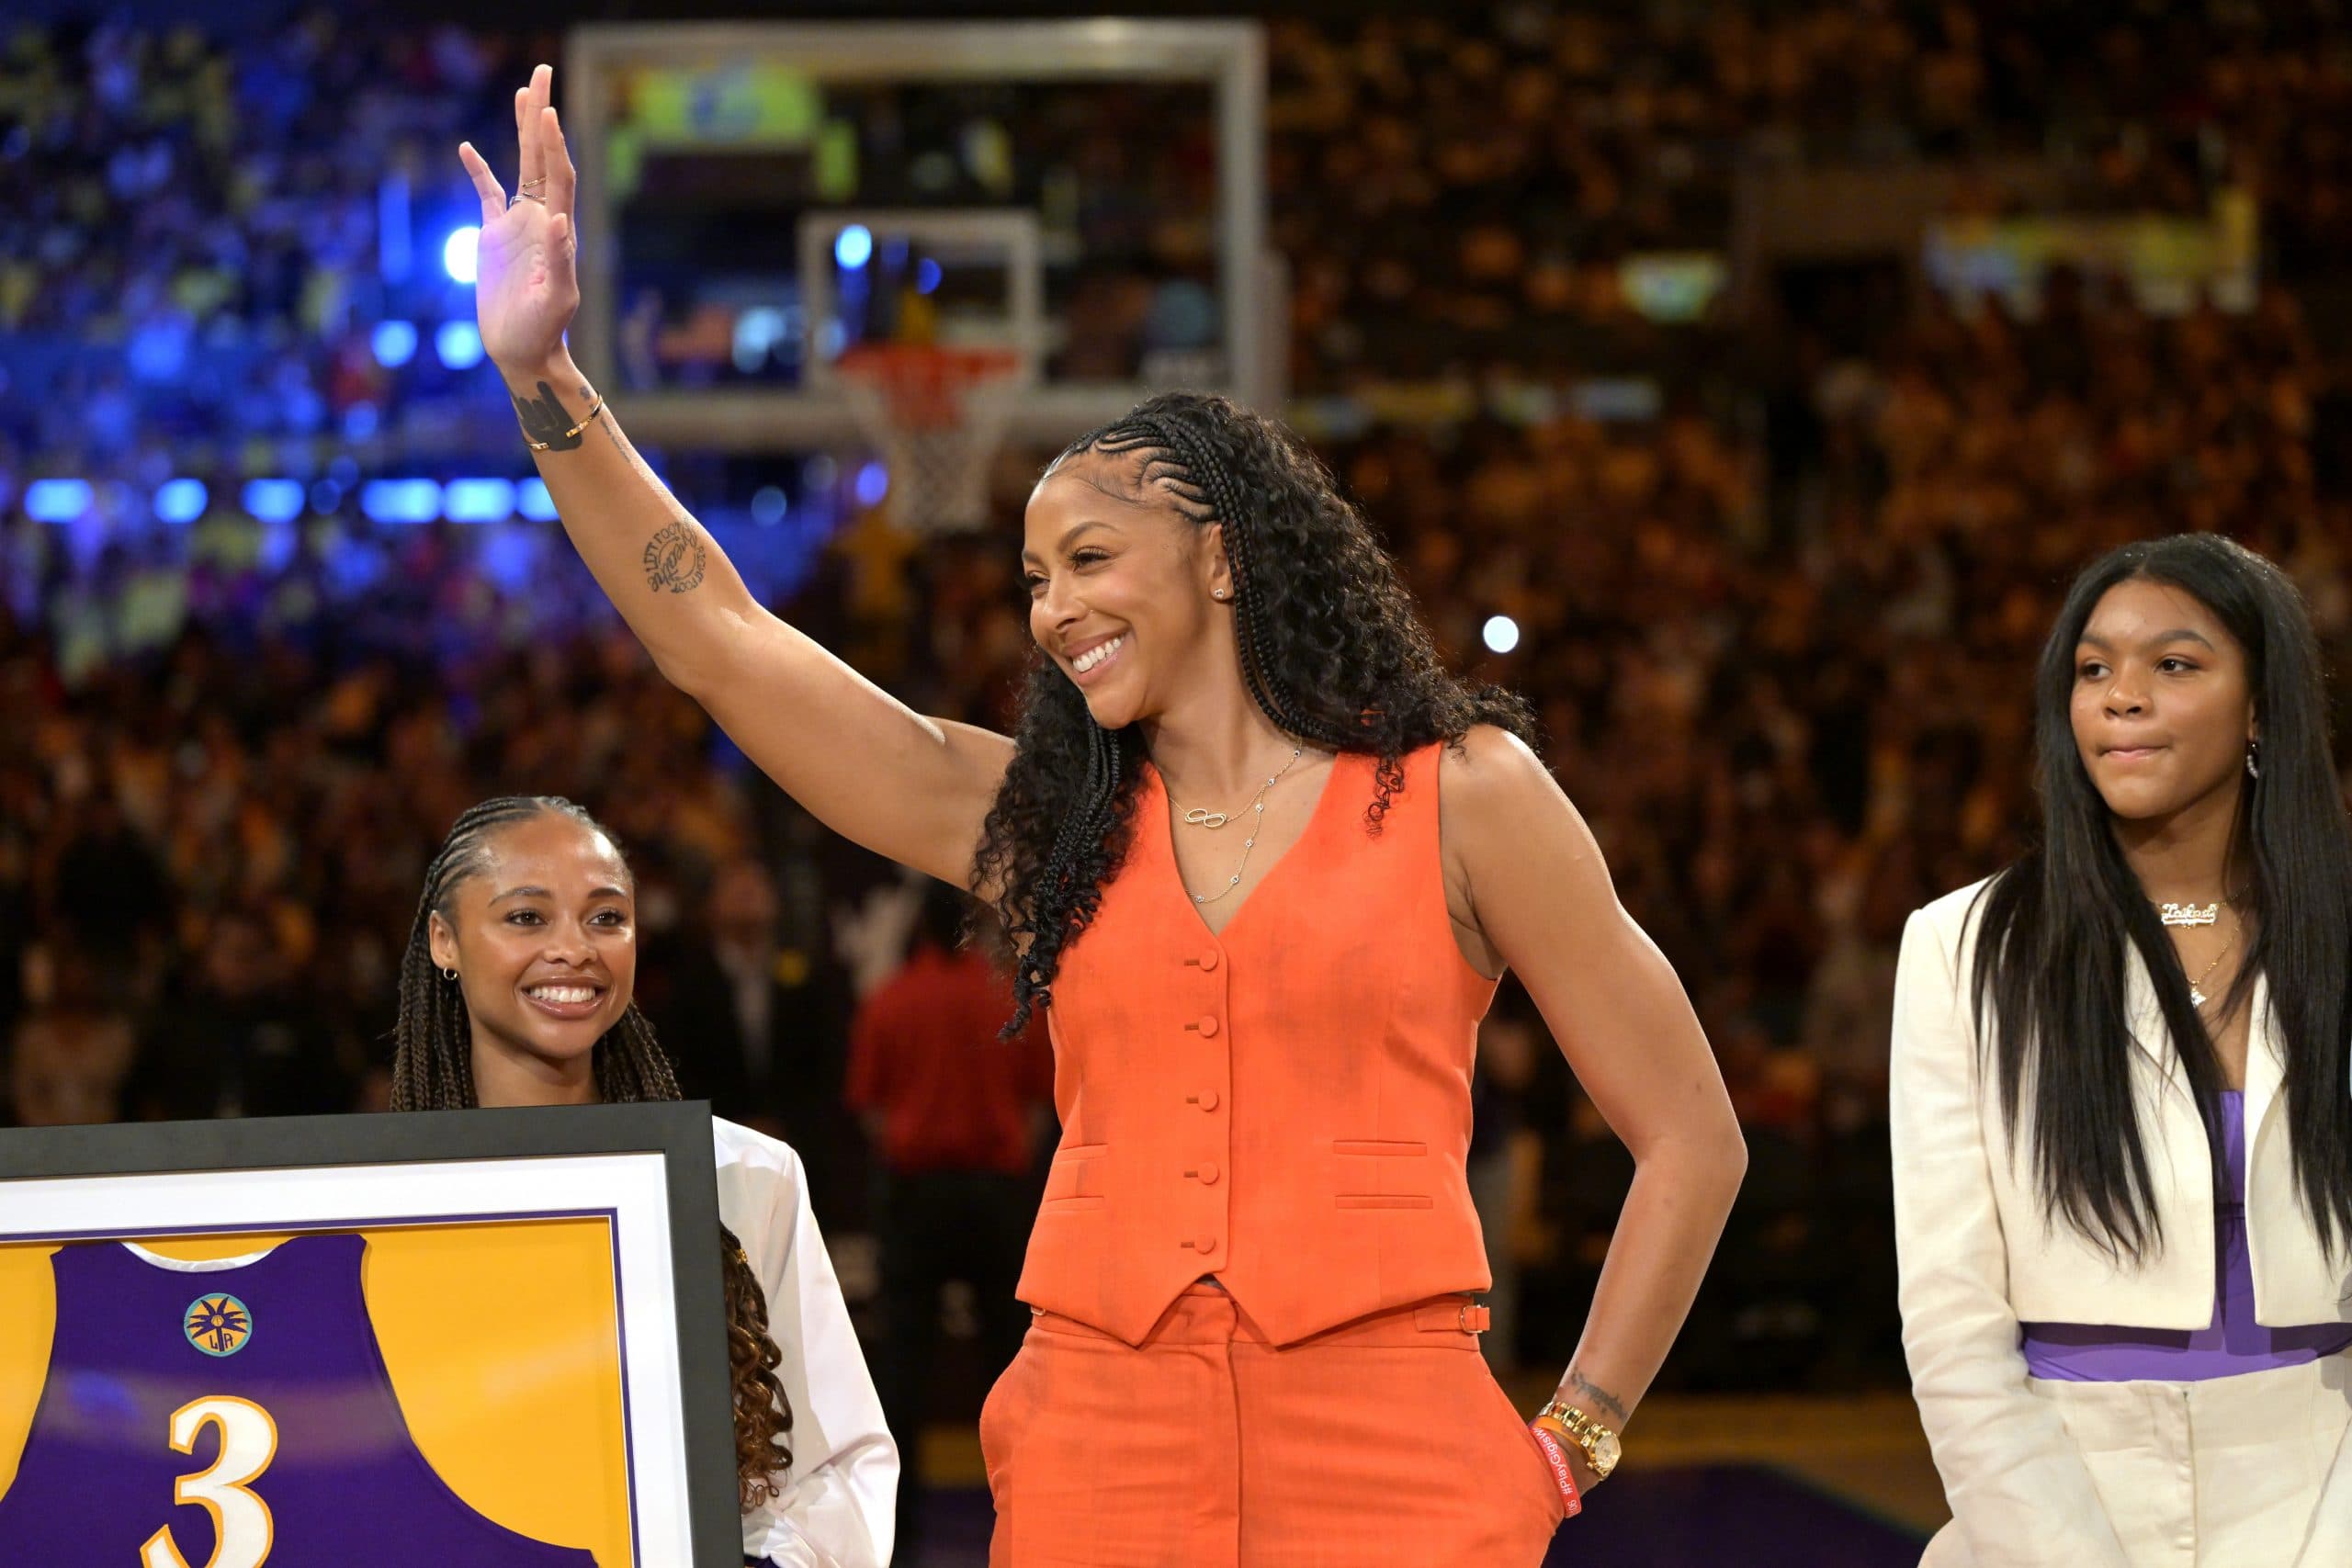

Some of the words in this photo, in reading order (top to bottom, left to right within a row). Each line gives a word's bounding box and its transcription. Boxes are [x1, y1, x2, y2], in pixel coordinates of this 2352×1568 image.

[209, 1333, 234, 1350] LA
[140, 1395, 277, 1568] 3
[1533, 1427, 1574, 1495] #PlayGigisW
